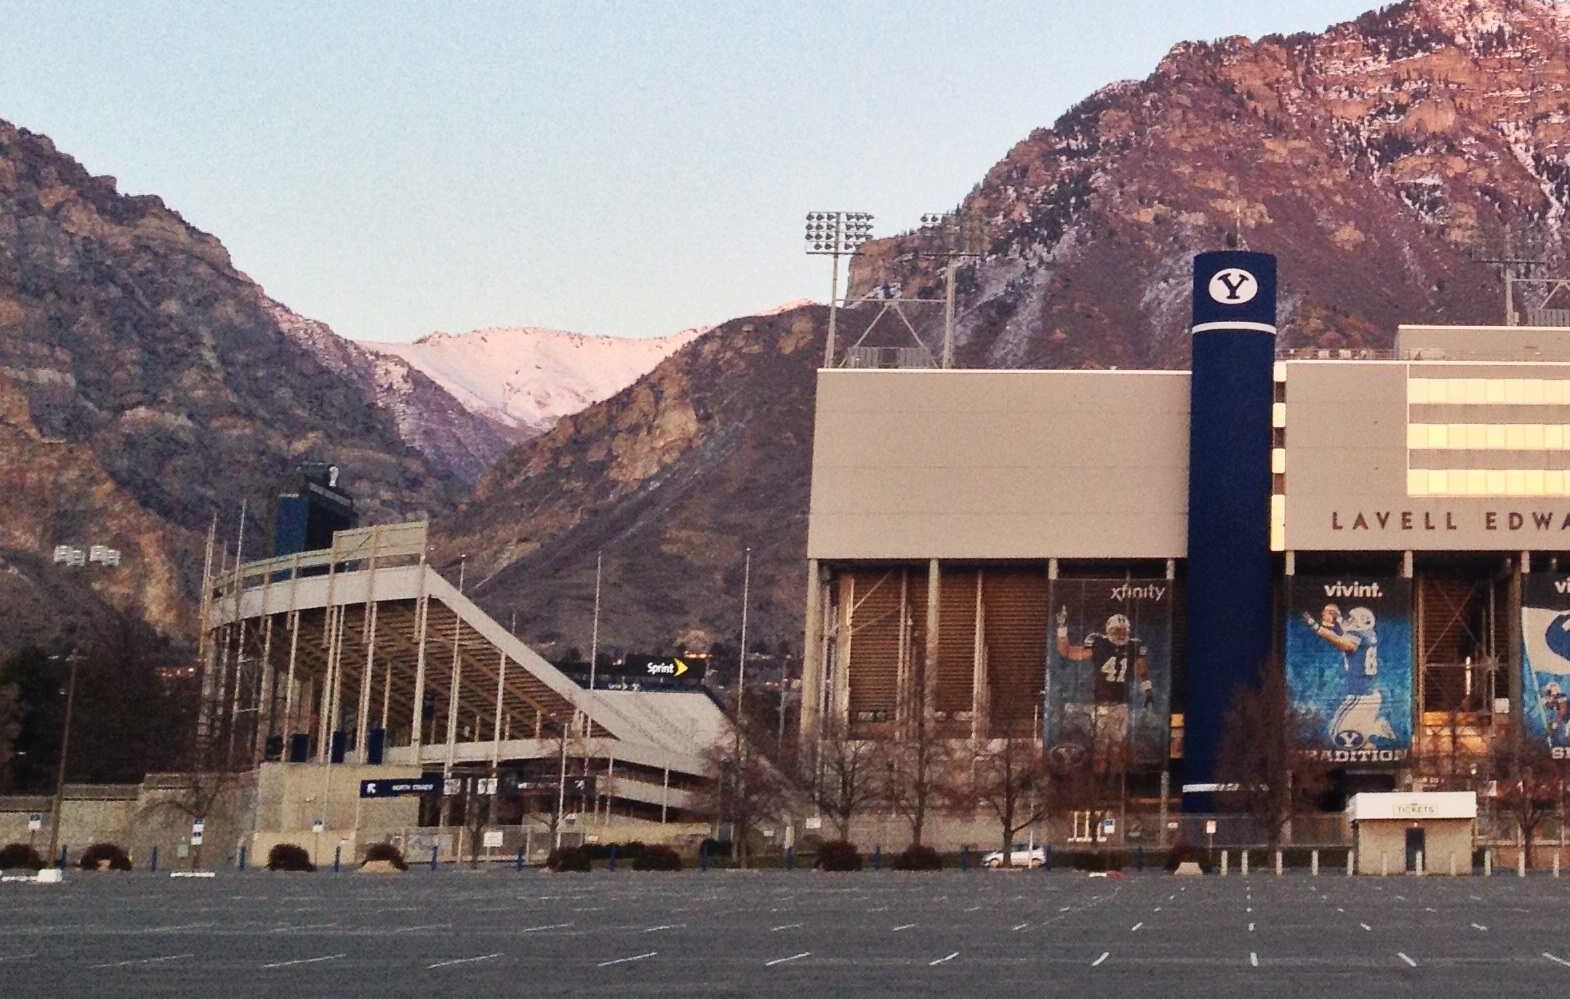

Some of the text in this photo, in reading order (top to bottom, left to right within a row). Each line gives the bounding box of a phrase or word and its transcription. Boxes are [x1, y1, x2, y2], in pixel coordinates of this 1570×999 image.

[1217, 272, 1249, 299] Y
[1332, 511, 1458, 530] LAVELL
[1110, 583, 1166, 601] xfinity
[647, 661, 675, 675] Sprint
[1101, 656, 1128, 683] 41
[1340, 731, 1361, 747] Y
